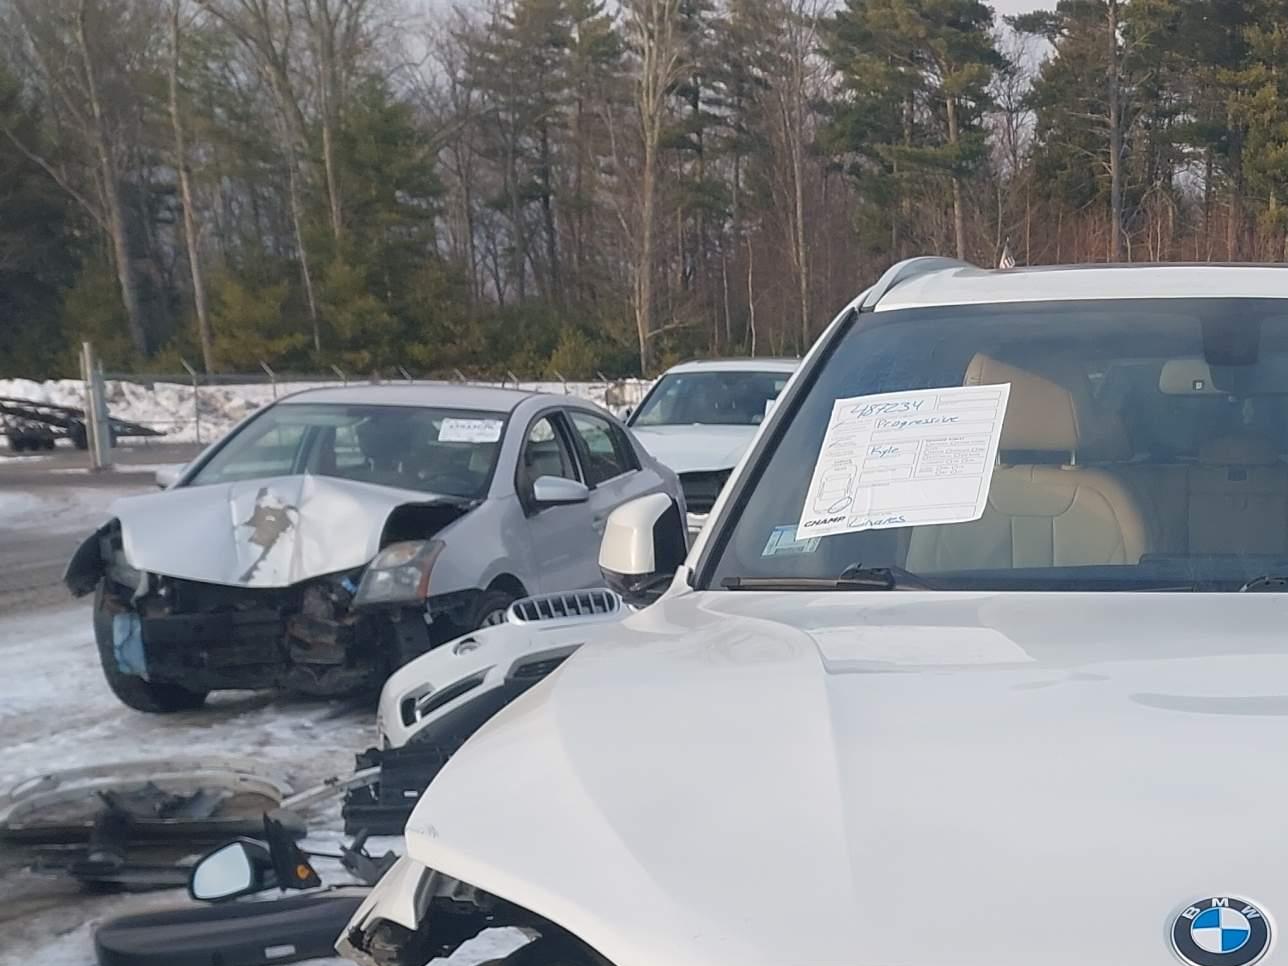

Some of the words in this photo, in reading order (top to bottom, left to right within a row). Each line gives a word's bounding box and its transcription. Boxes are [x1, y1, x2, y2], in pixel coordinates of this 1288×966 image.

[877, 416, 960, 430] Progressive
[871, 446, 900, 459] Kyle
[1182, 897, 1260, 920] BMW
